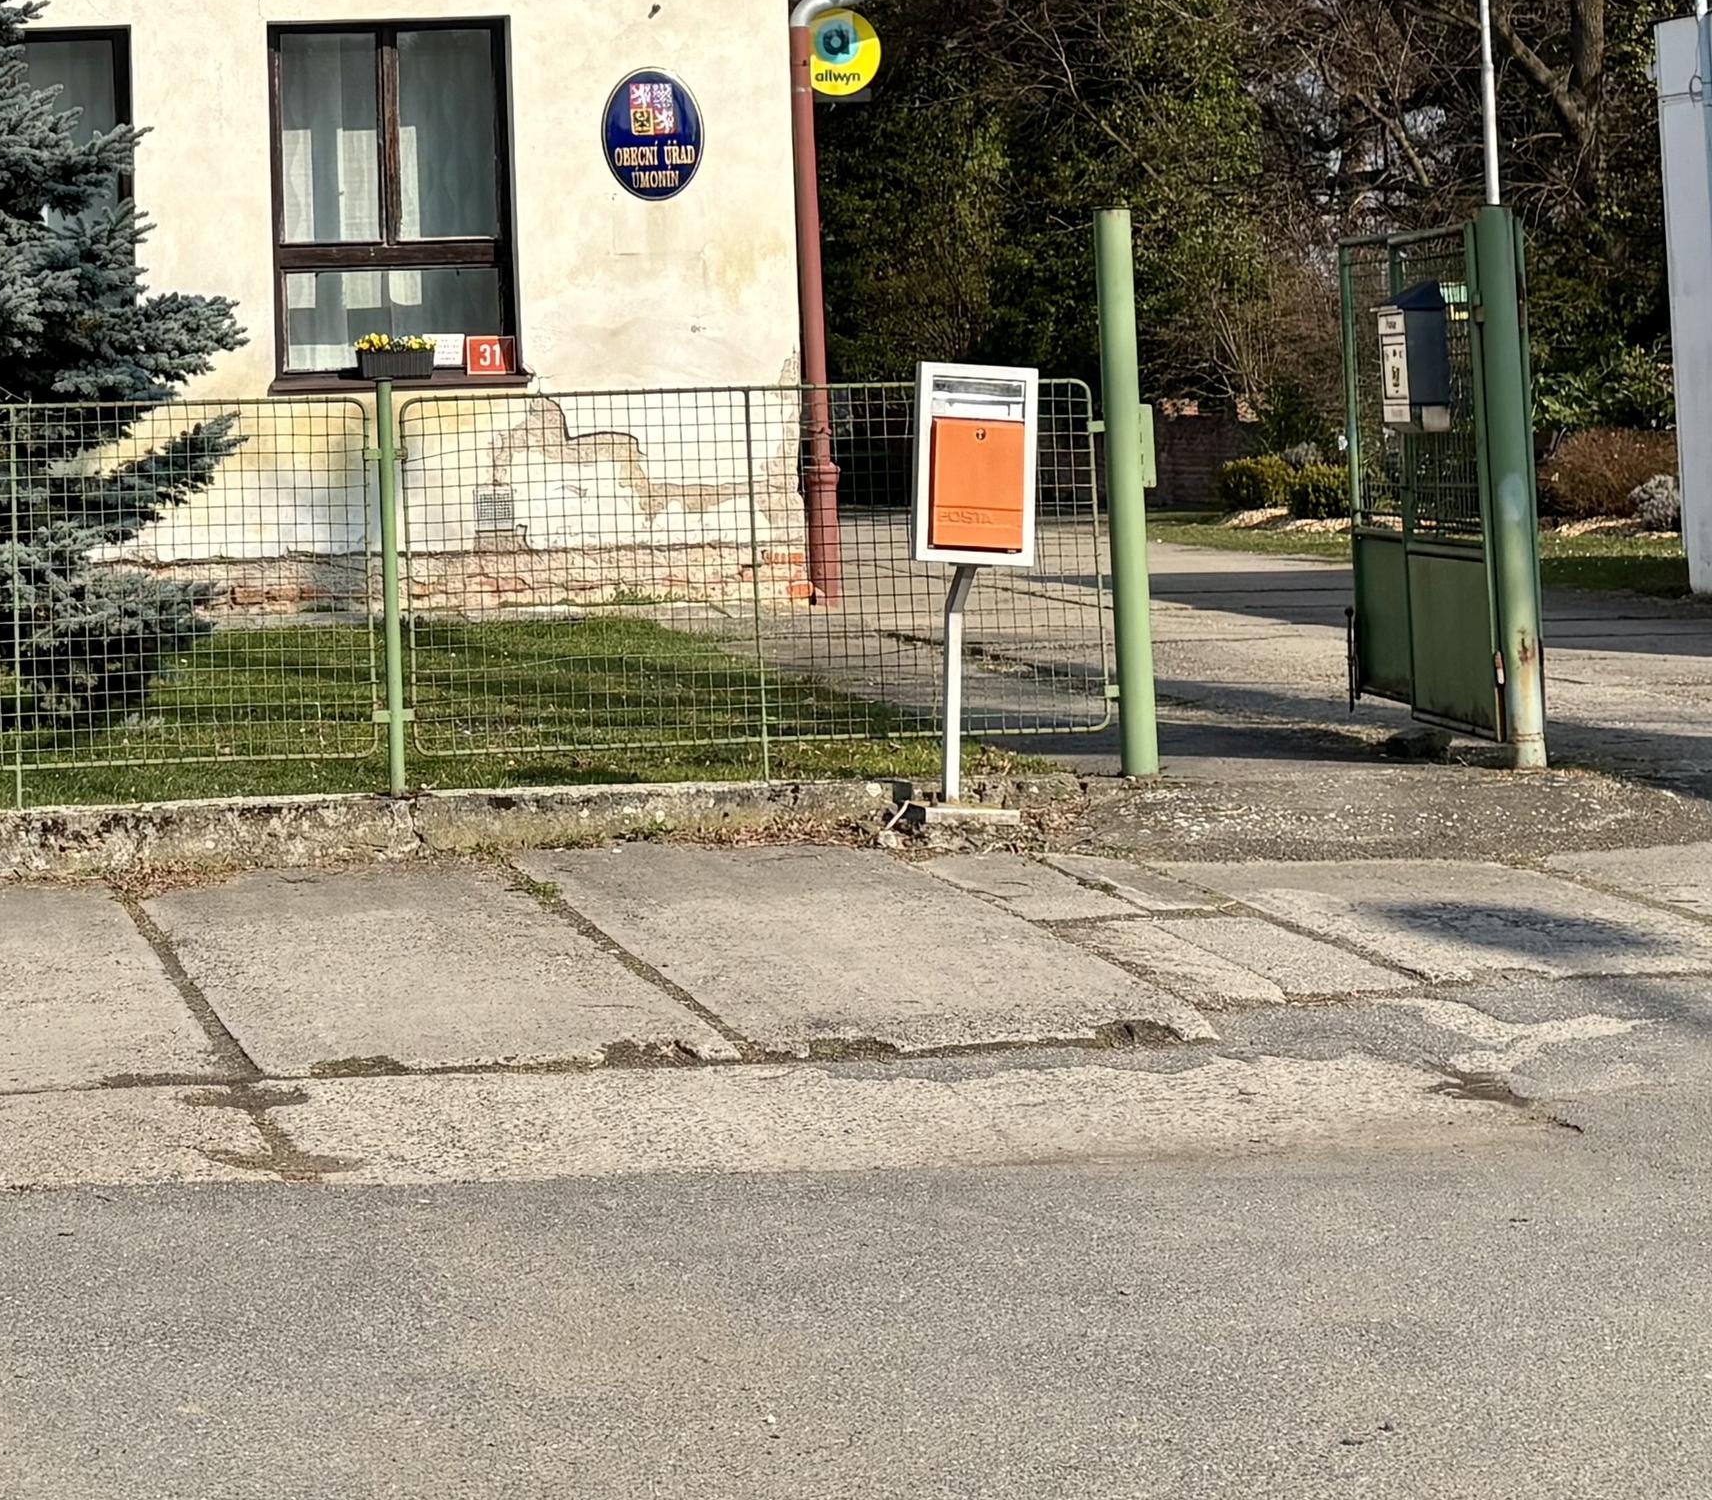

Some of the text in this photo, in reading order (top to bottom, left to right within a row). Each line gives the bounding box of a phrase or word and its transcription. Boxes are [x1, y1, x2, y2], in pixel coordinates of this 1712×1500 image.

[815, 69, 861, 86] allwyn
[614, 140, 696, 167] OBECNÍ ÚŘAD
[631, 166, 680, 189] ÚMONÍN
[479, 343, 502, 367] 31
